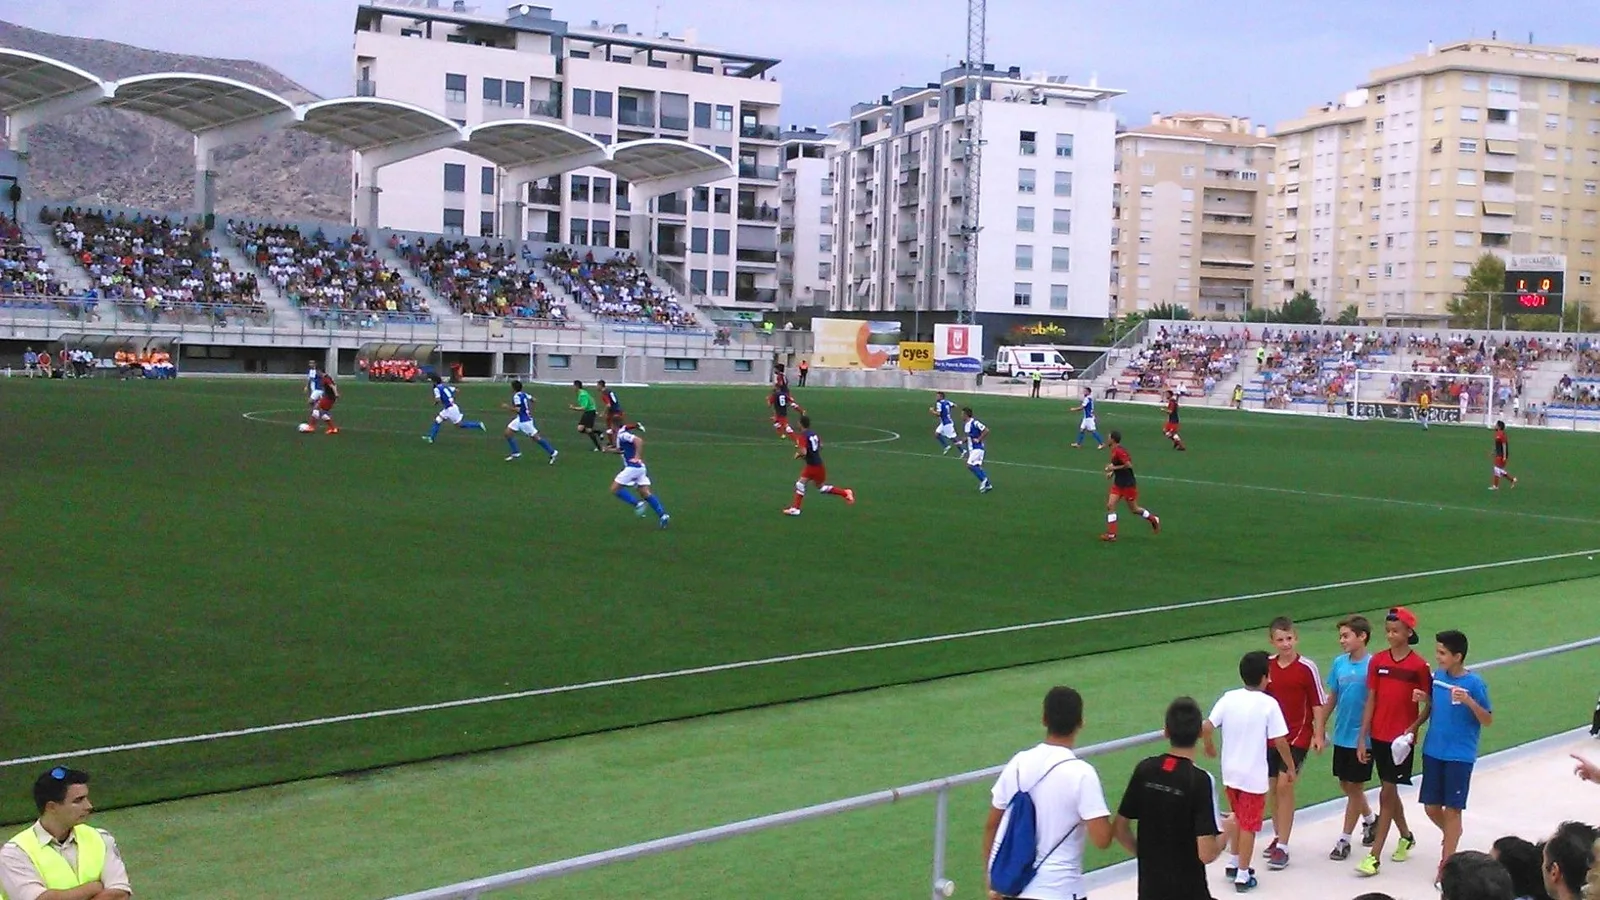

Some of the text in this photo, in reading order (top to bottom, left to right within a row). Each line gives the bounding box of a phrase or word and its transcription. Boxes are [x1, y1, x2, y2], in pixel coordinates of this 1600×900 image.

[1541, 279, 1550, 290] 0
[902, 348, 929, 360] cyes
[779, 394, 786, 406] 6
